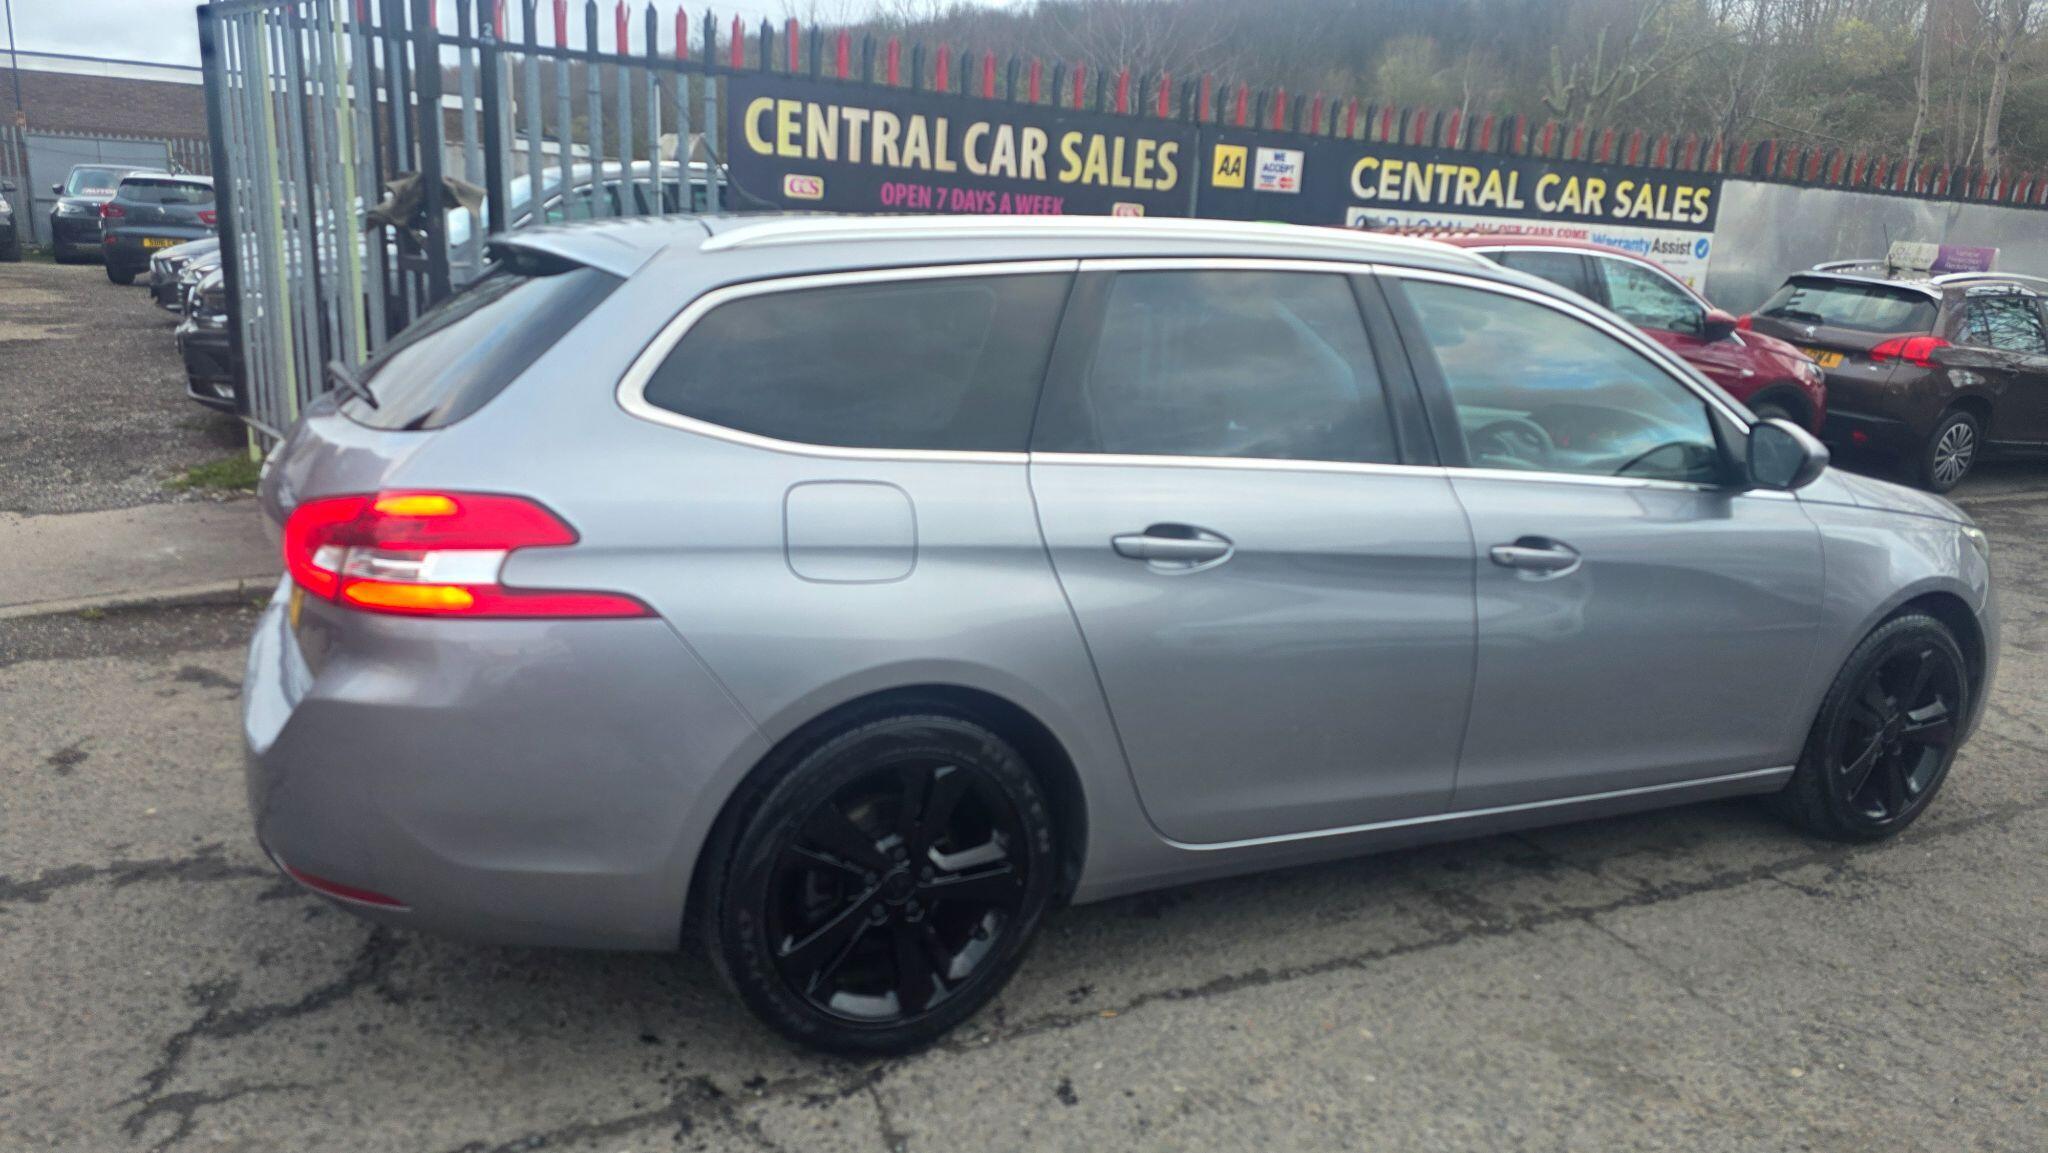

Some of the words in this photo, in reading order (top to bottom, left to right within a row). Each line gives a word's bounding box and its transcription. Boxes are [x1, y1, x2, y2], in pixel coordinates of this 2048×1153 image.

[744, 96, 957, 174] CENTRAL
[963, 121, 1048, 181] CAR
[1058, 131, 1179, 191] SALES
[1217, 154, 1241, 177] AA
[1262, 163, 1296, 174] ACCEPT
[789, 178, 820, 196] CCS
[880, 181, 932, 210] OPEN
[936, 187, 948, 210] 7
[950, 188, 997, 213] DAYS
[998, 191, 1012, 215] A
[1015, 194, 1065, 215] WEEK
[1350, 156, 1524, 210] CENTRAL
[1535, 173, 1606, 217] CAR
[1611, 180, 1712, 224] SALES
[1525, 226, 1554, 236] CARS
[1558, 228, 1589, 239] COME
